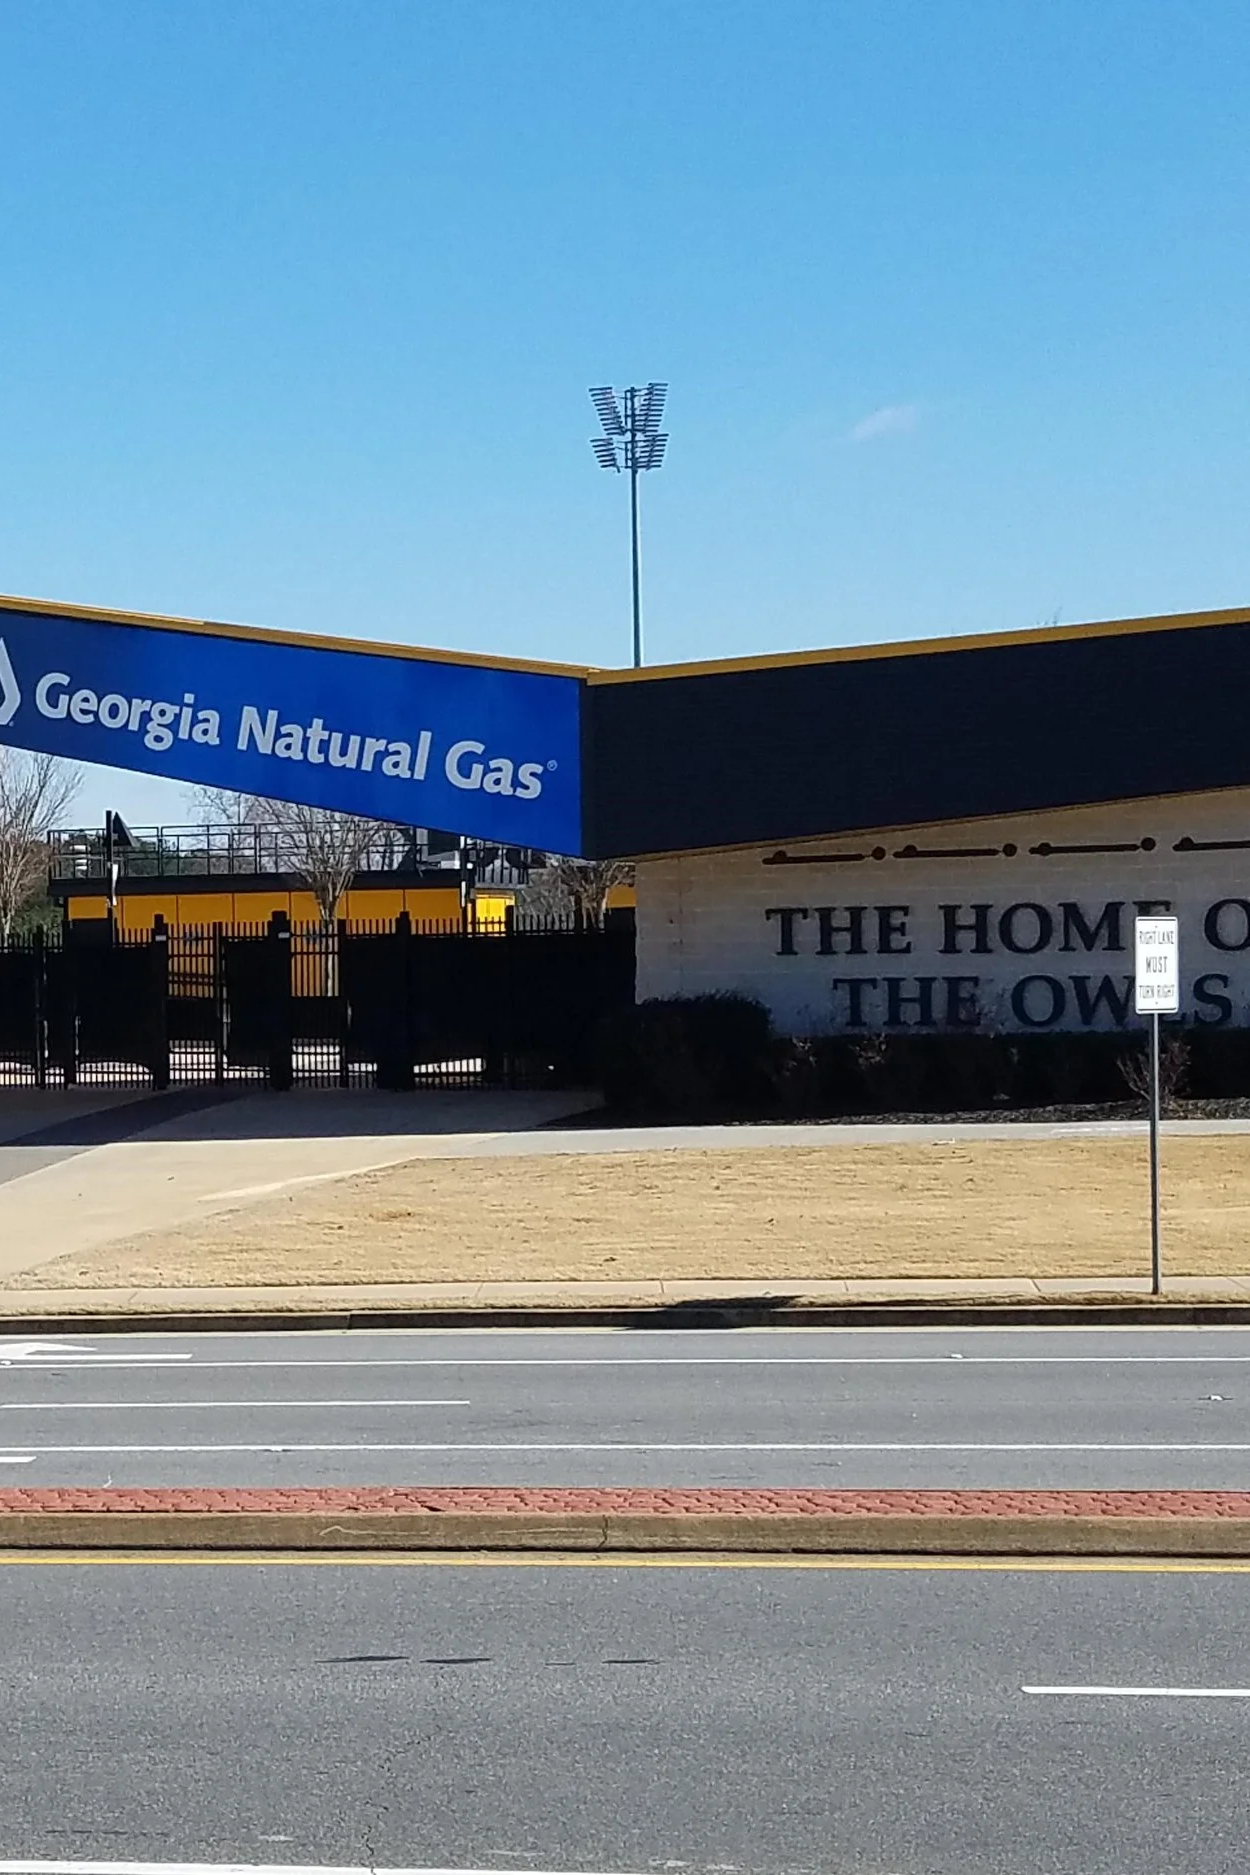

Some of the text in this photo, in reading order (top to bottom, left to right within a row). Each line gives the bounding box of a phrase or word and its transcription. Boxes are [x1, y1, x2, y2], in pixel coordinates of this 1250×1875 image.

[35, 672, 220, 752] Georgia
[237, 706, 432, 781] Natural
[765, 905, 913, 956] THE
[1139, 930, 1175, 945] RIGHT LANE
[1146, 956, 1168, 973] MUST
[832, 973, 1233, 1027] THE OWS
[1139, 984, 1175, 999] TURN RIGHT
